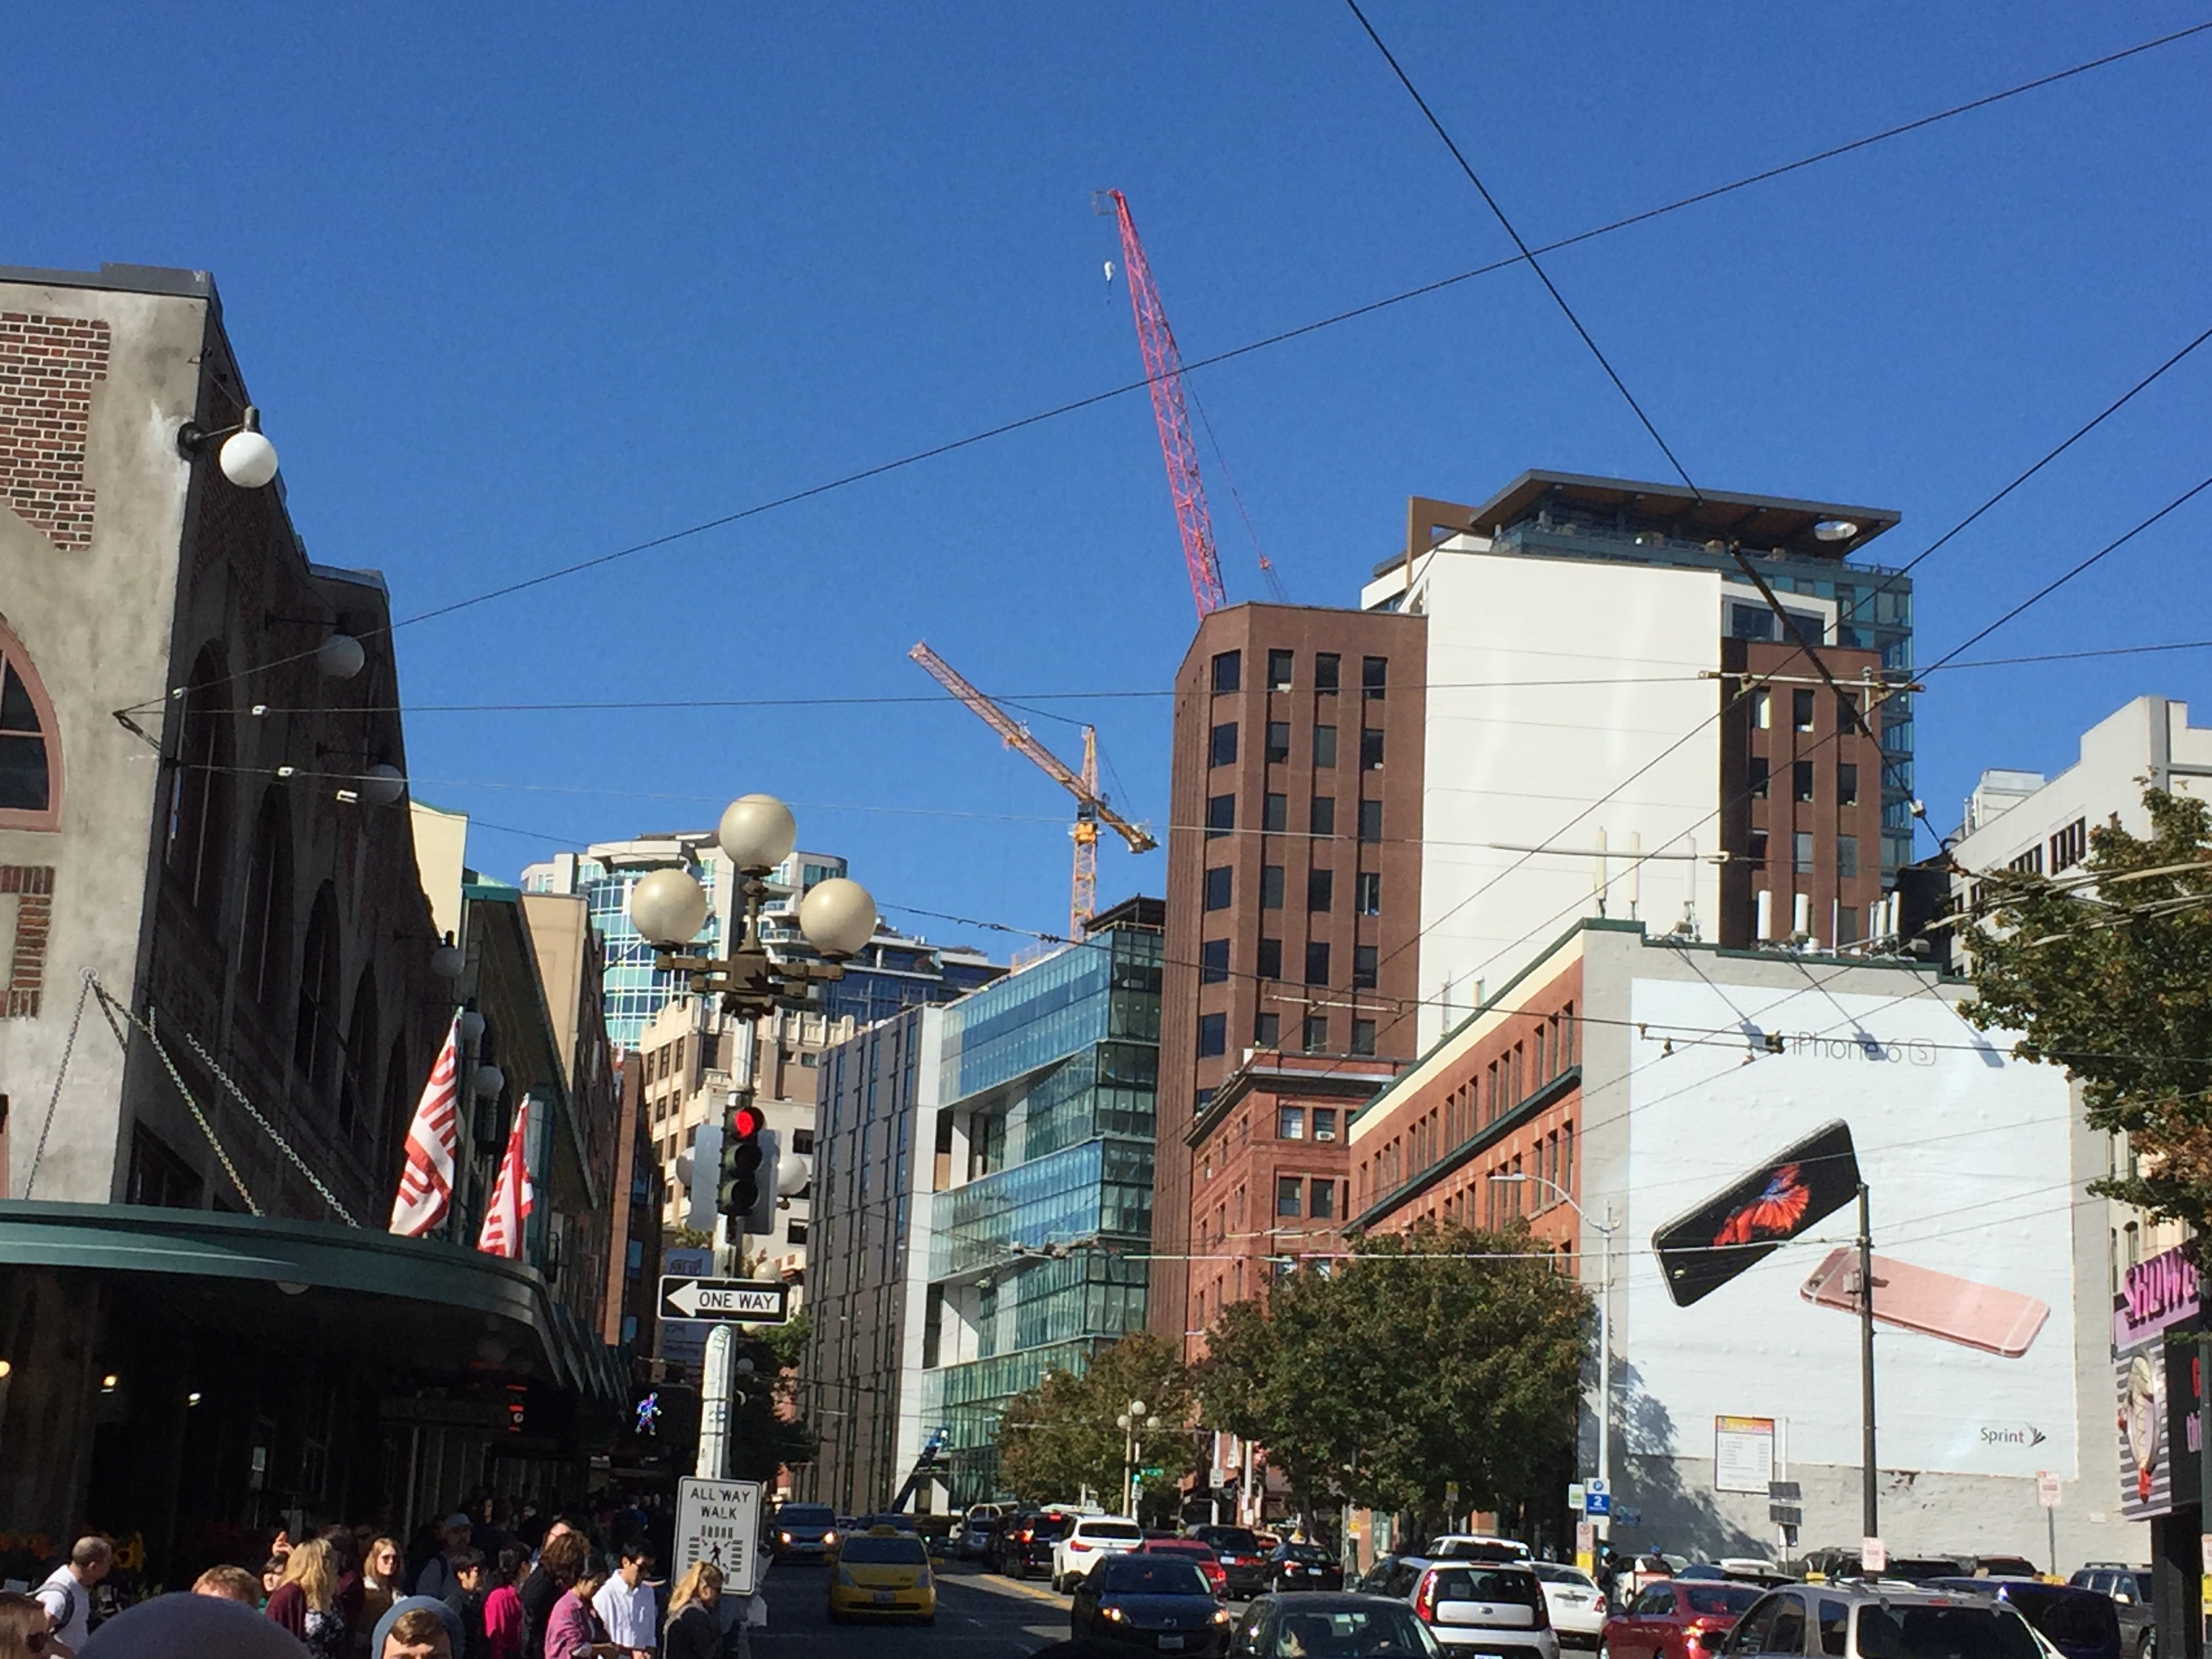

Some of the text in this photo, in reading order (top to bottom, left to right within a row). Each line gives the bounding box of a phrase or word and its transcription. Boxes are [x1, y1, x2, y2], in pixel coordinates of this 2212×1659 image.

[1793, 1031, 1879, 1061] iPhone
[699, 1291, 775, 1310] ONE WAY
[1980, 1427, 2024, 1445] Sprint
[690, 1486, 751, 1503] ALL WAY
[1593, 1496, 1603, 1507] 2
[701, 1505, 737, 1520] WALK
